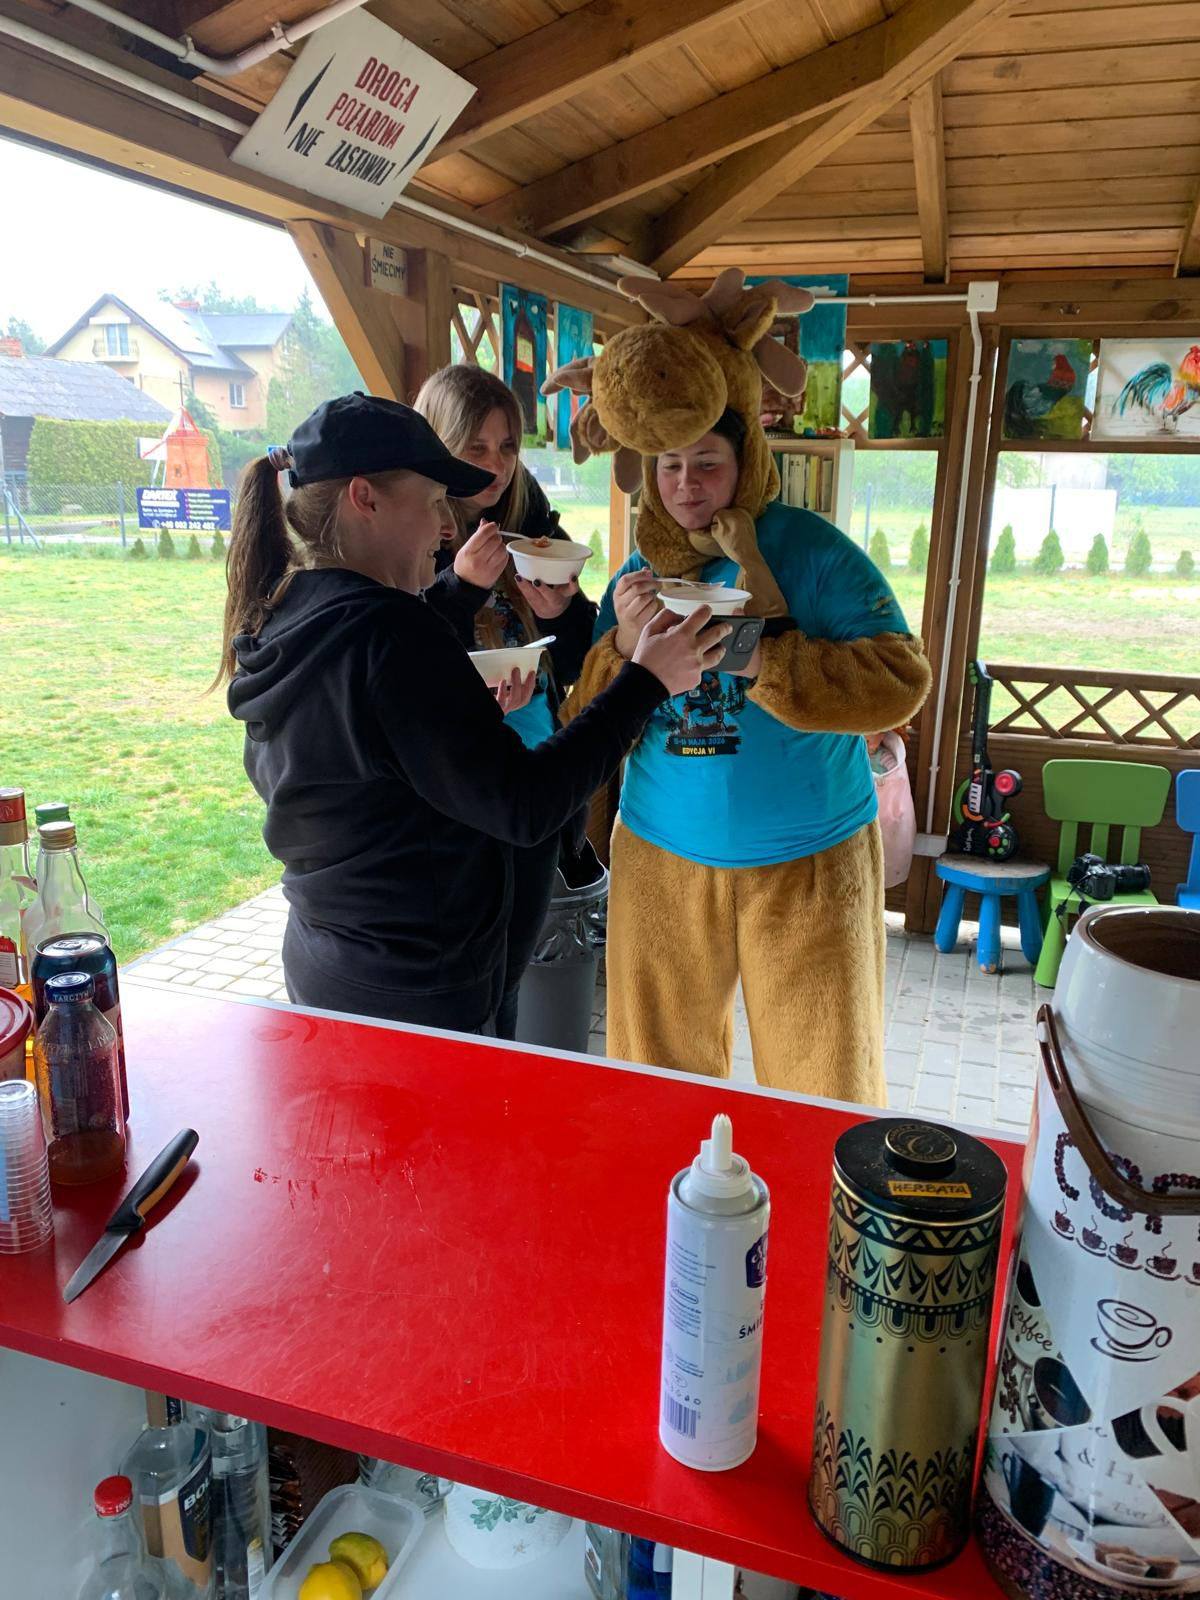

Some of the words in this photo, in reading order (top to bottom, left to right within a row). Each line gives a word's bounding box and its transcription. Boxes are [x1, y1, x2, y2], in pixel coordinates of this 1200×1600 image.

[354, 56, 420, 114] DROGA
[287, 122, 325, 158] NIE
[324, 139, 397, 187] ZASTAWIAJ
[382, 243, 394, 260] NIE
[682, 747, 706, 755] EDYCJA
[707, 746, 716, 755] VI
[893, 1183, 968, 1195] HERBATA
[1009, 1304, 1054, 1351] coffee
